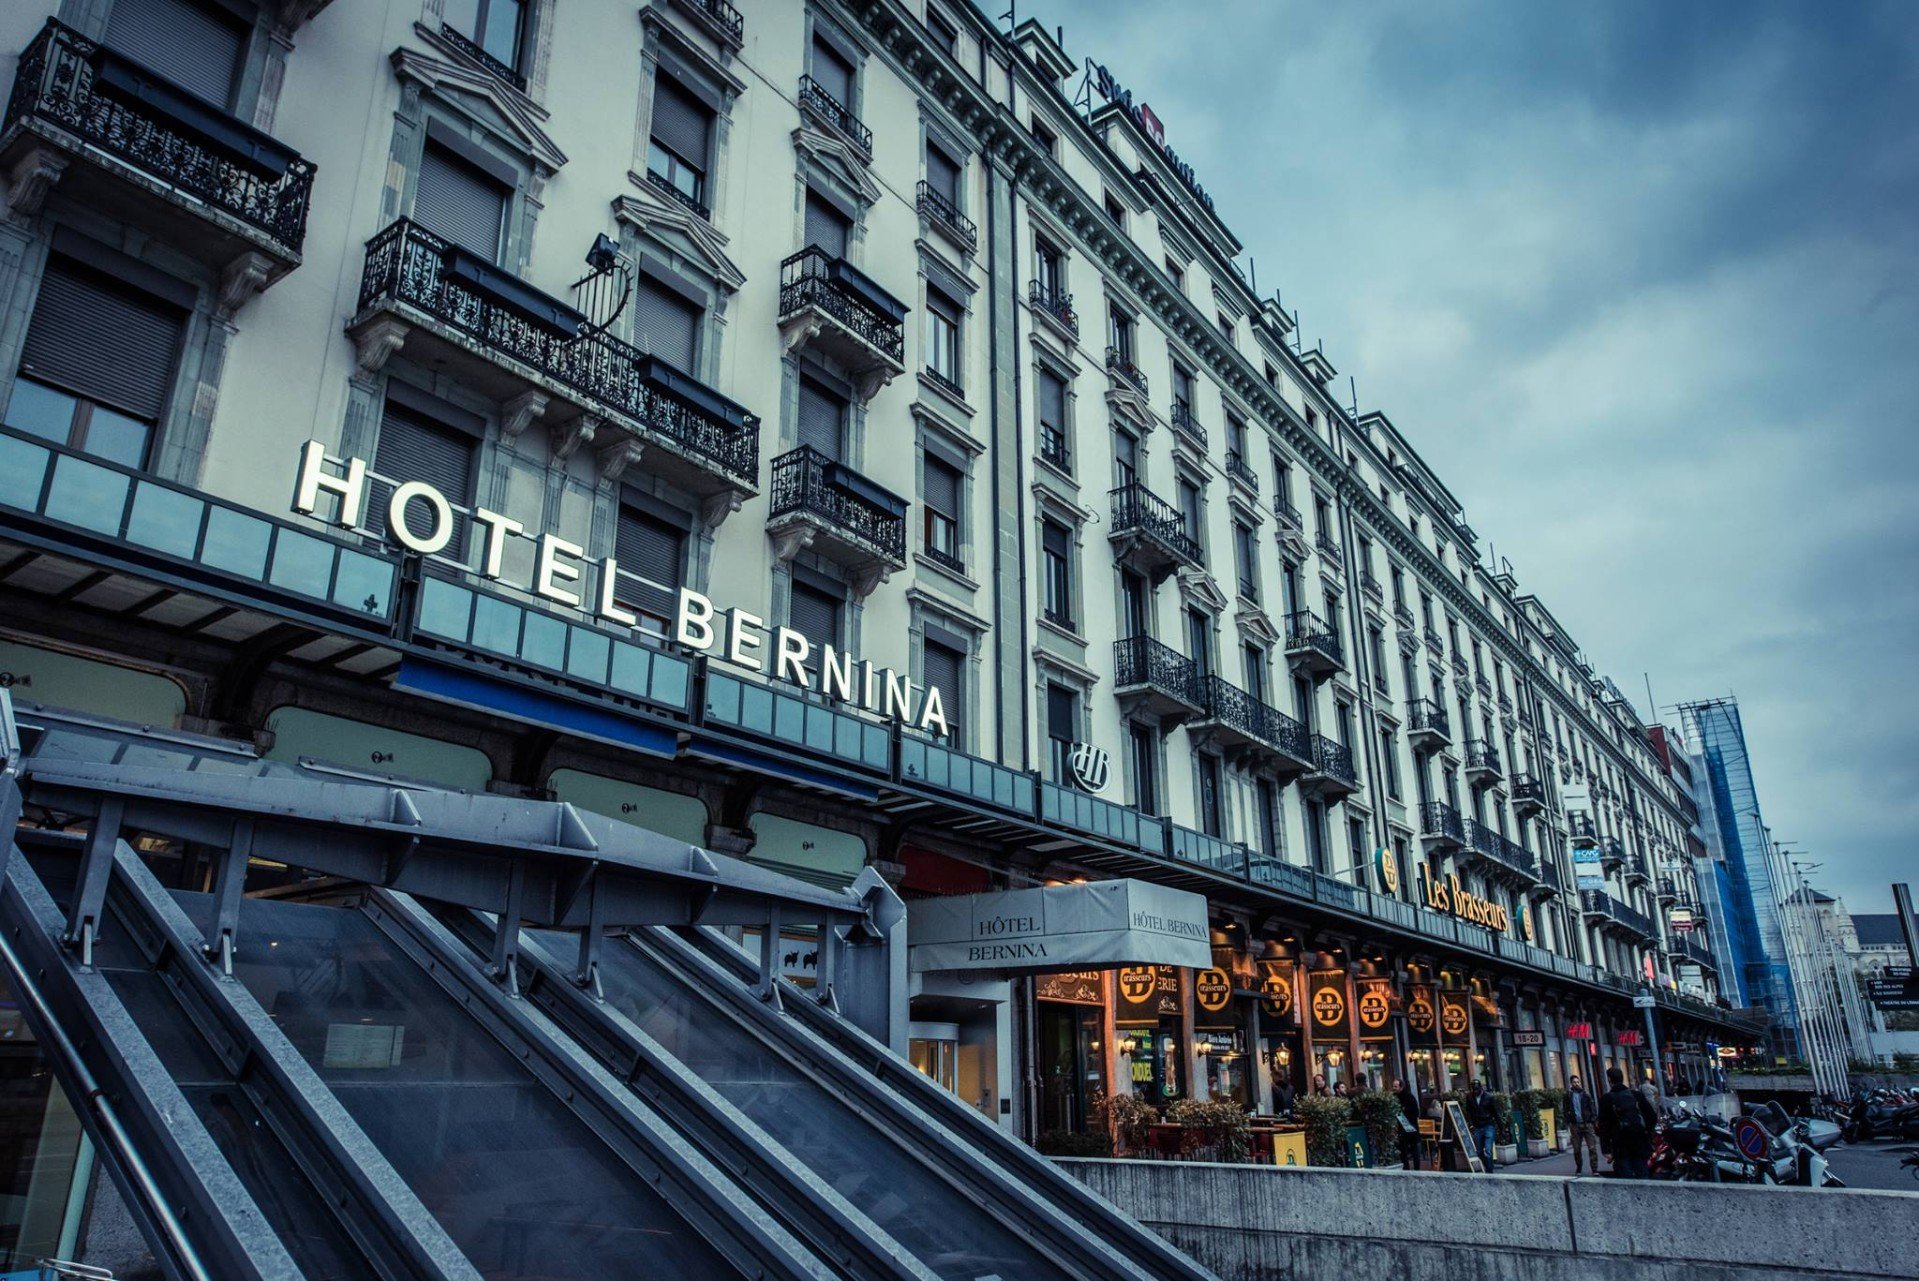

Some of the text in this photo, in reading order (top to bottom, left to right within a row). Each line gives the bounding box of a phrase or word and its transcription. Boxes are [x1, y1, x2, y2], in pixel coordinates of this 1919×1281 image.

[291, 439, 637, 627] HOTEL
[668, 586, 949, 737] BERNINA
[1421, 861, 1450, 911] Les
[1448, 874, 1508, 932] Brasseurs
[980, 915, 1042, 936] HÔTEL
[1133, 910, 1207, 938] HÔTEL BERNINA
[968, 942, 1048, 961] BERNINA
